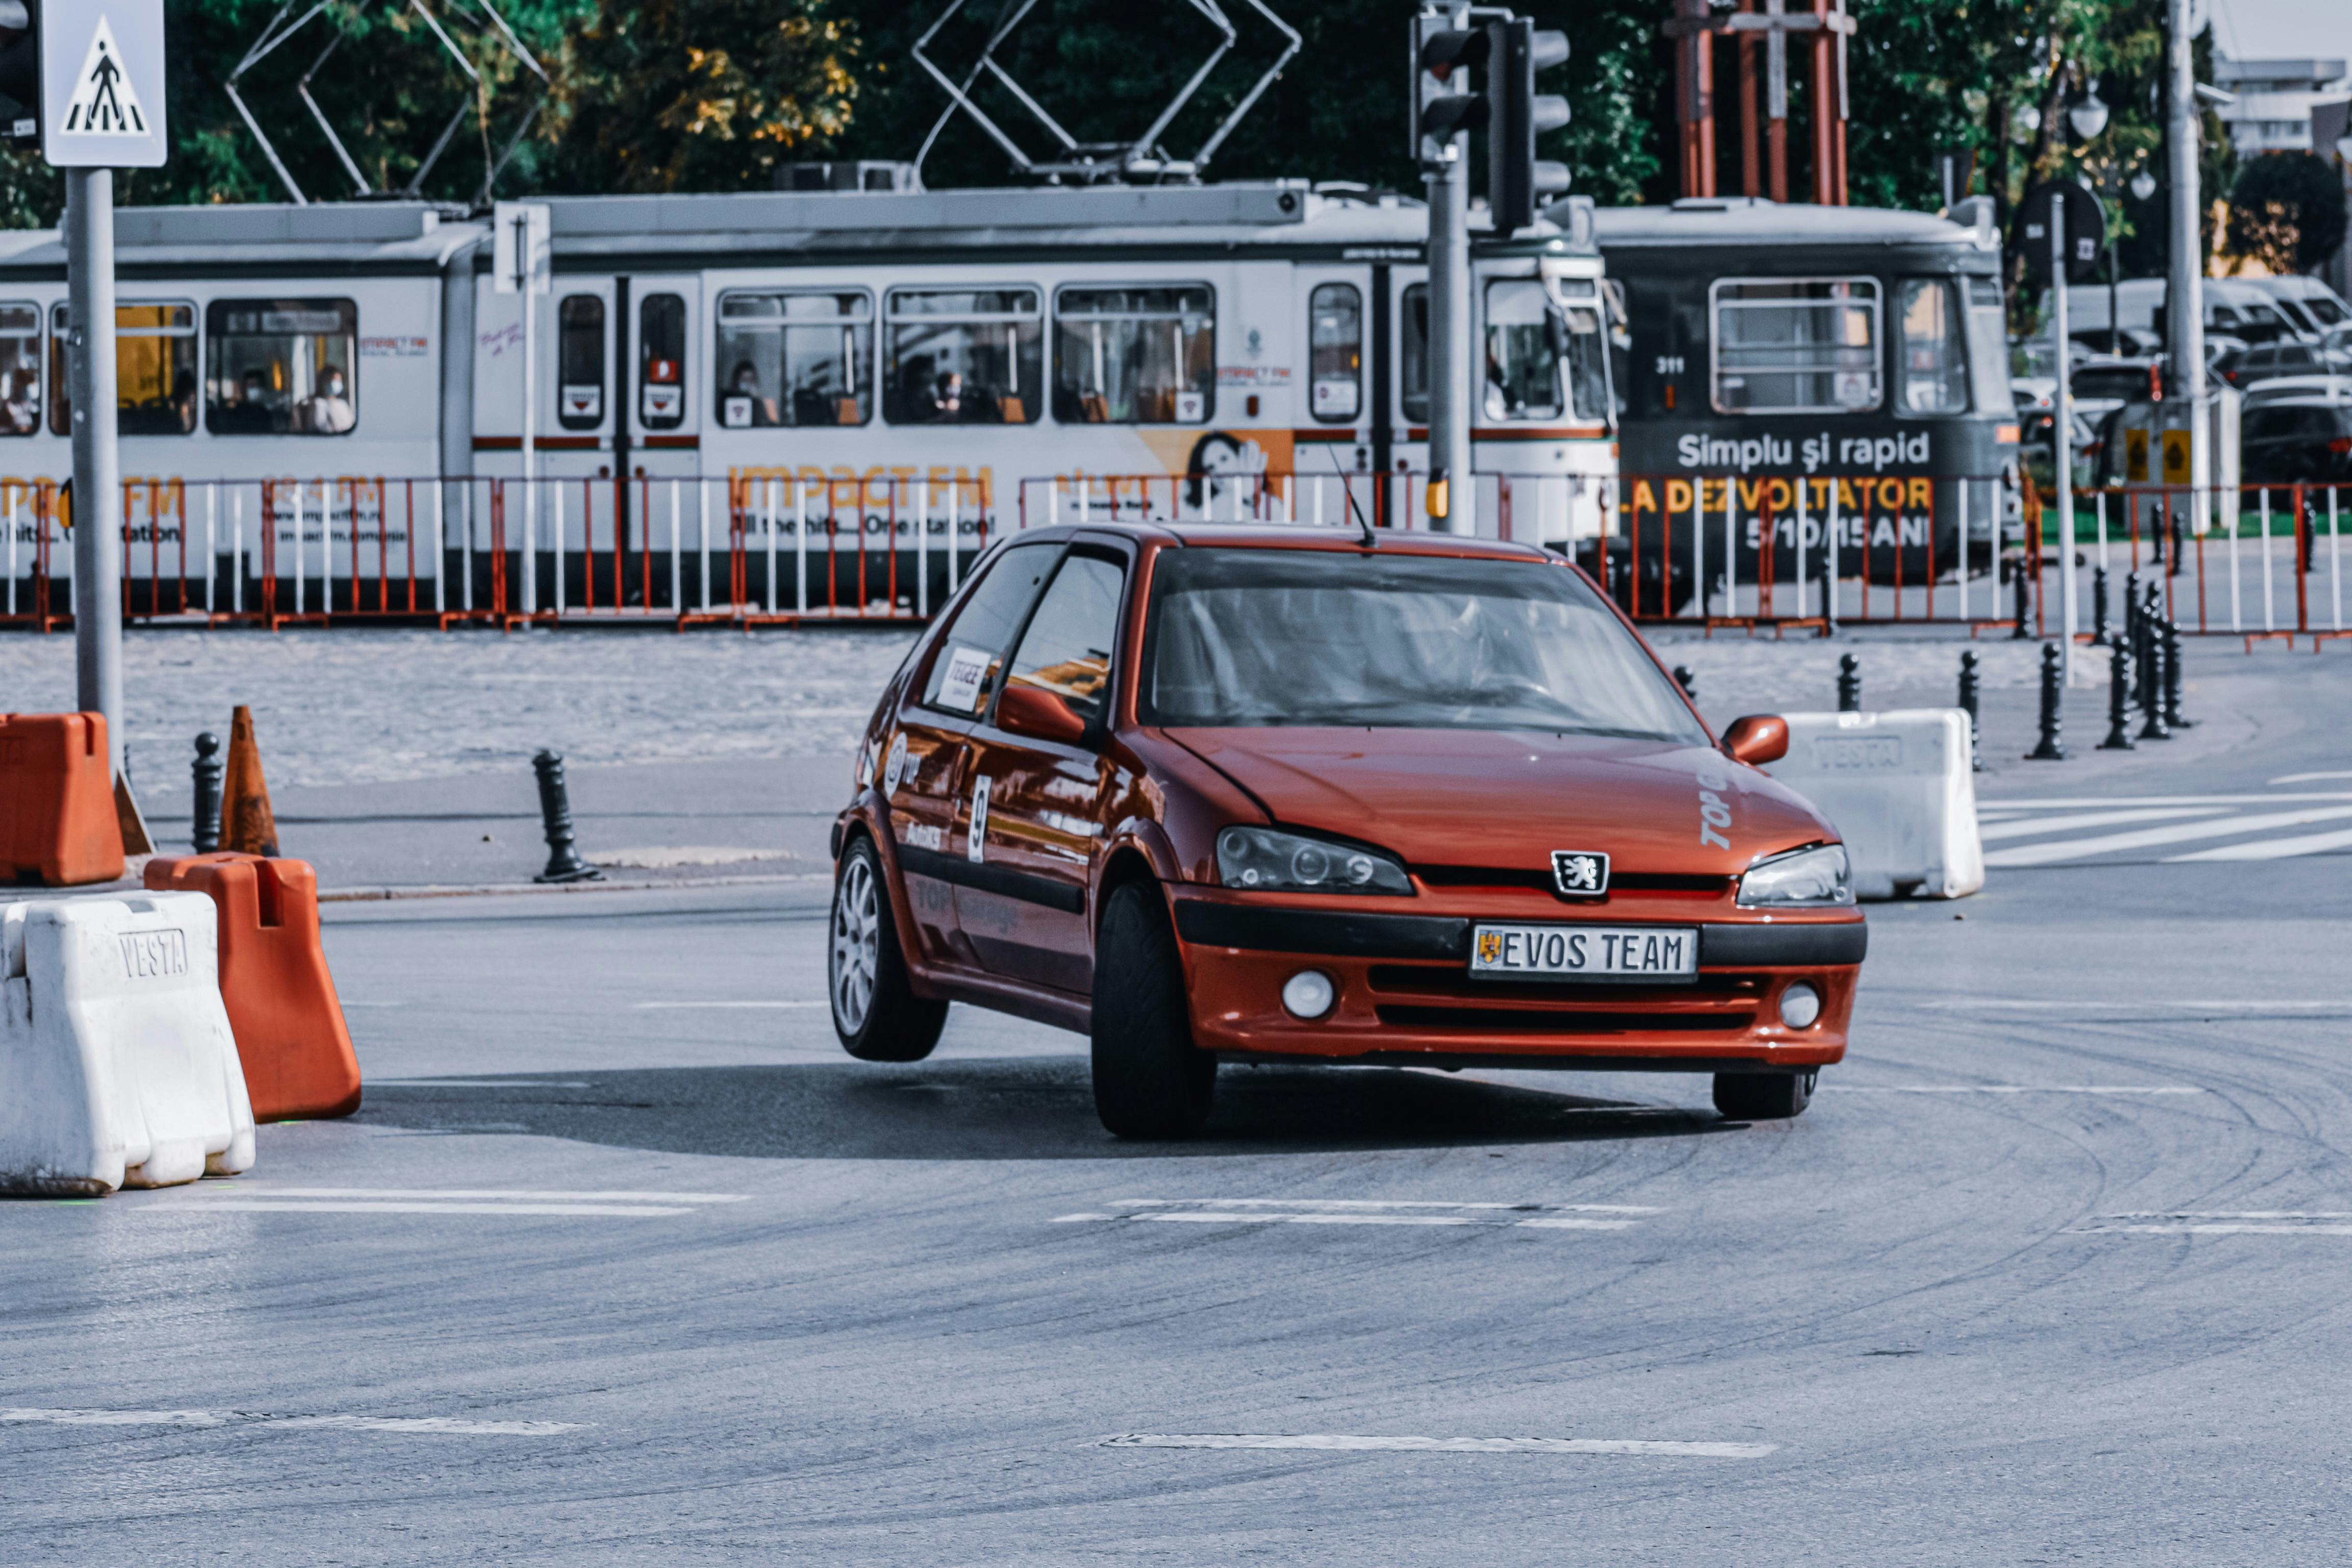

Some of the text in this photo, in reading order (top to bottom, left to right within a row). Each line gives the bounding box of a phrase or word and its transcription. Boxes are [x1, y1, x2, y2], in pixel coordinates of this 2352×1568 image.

[1656, 356, 1684, 374] 311
[1677, 433, 1793, 474] Simplu
[1839, 431, 1930, 472] rapid
[928, 466, 993, 508] FM
[1619, 477, 1931, 512] A DEZVOLTATOR
[1700, 791, 1732, 851] TOP
[120, 934, 184, 977] VESTA
[1502, 932, 1682, 970] EVOS TEAM
